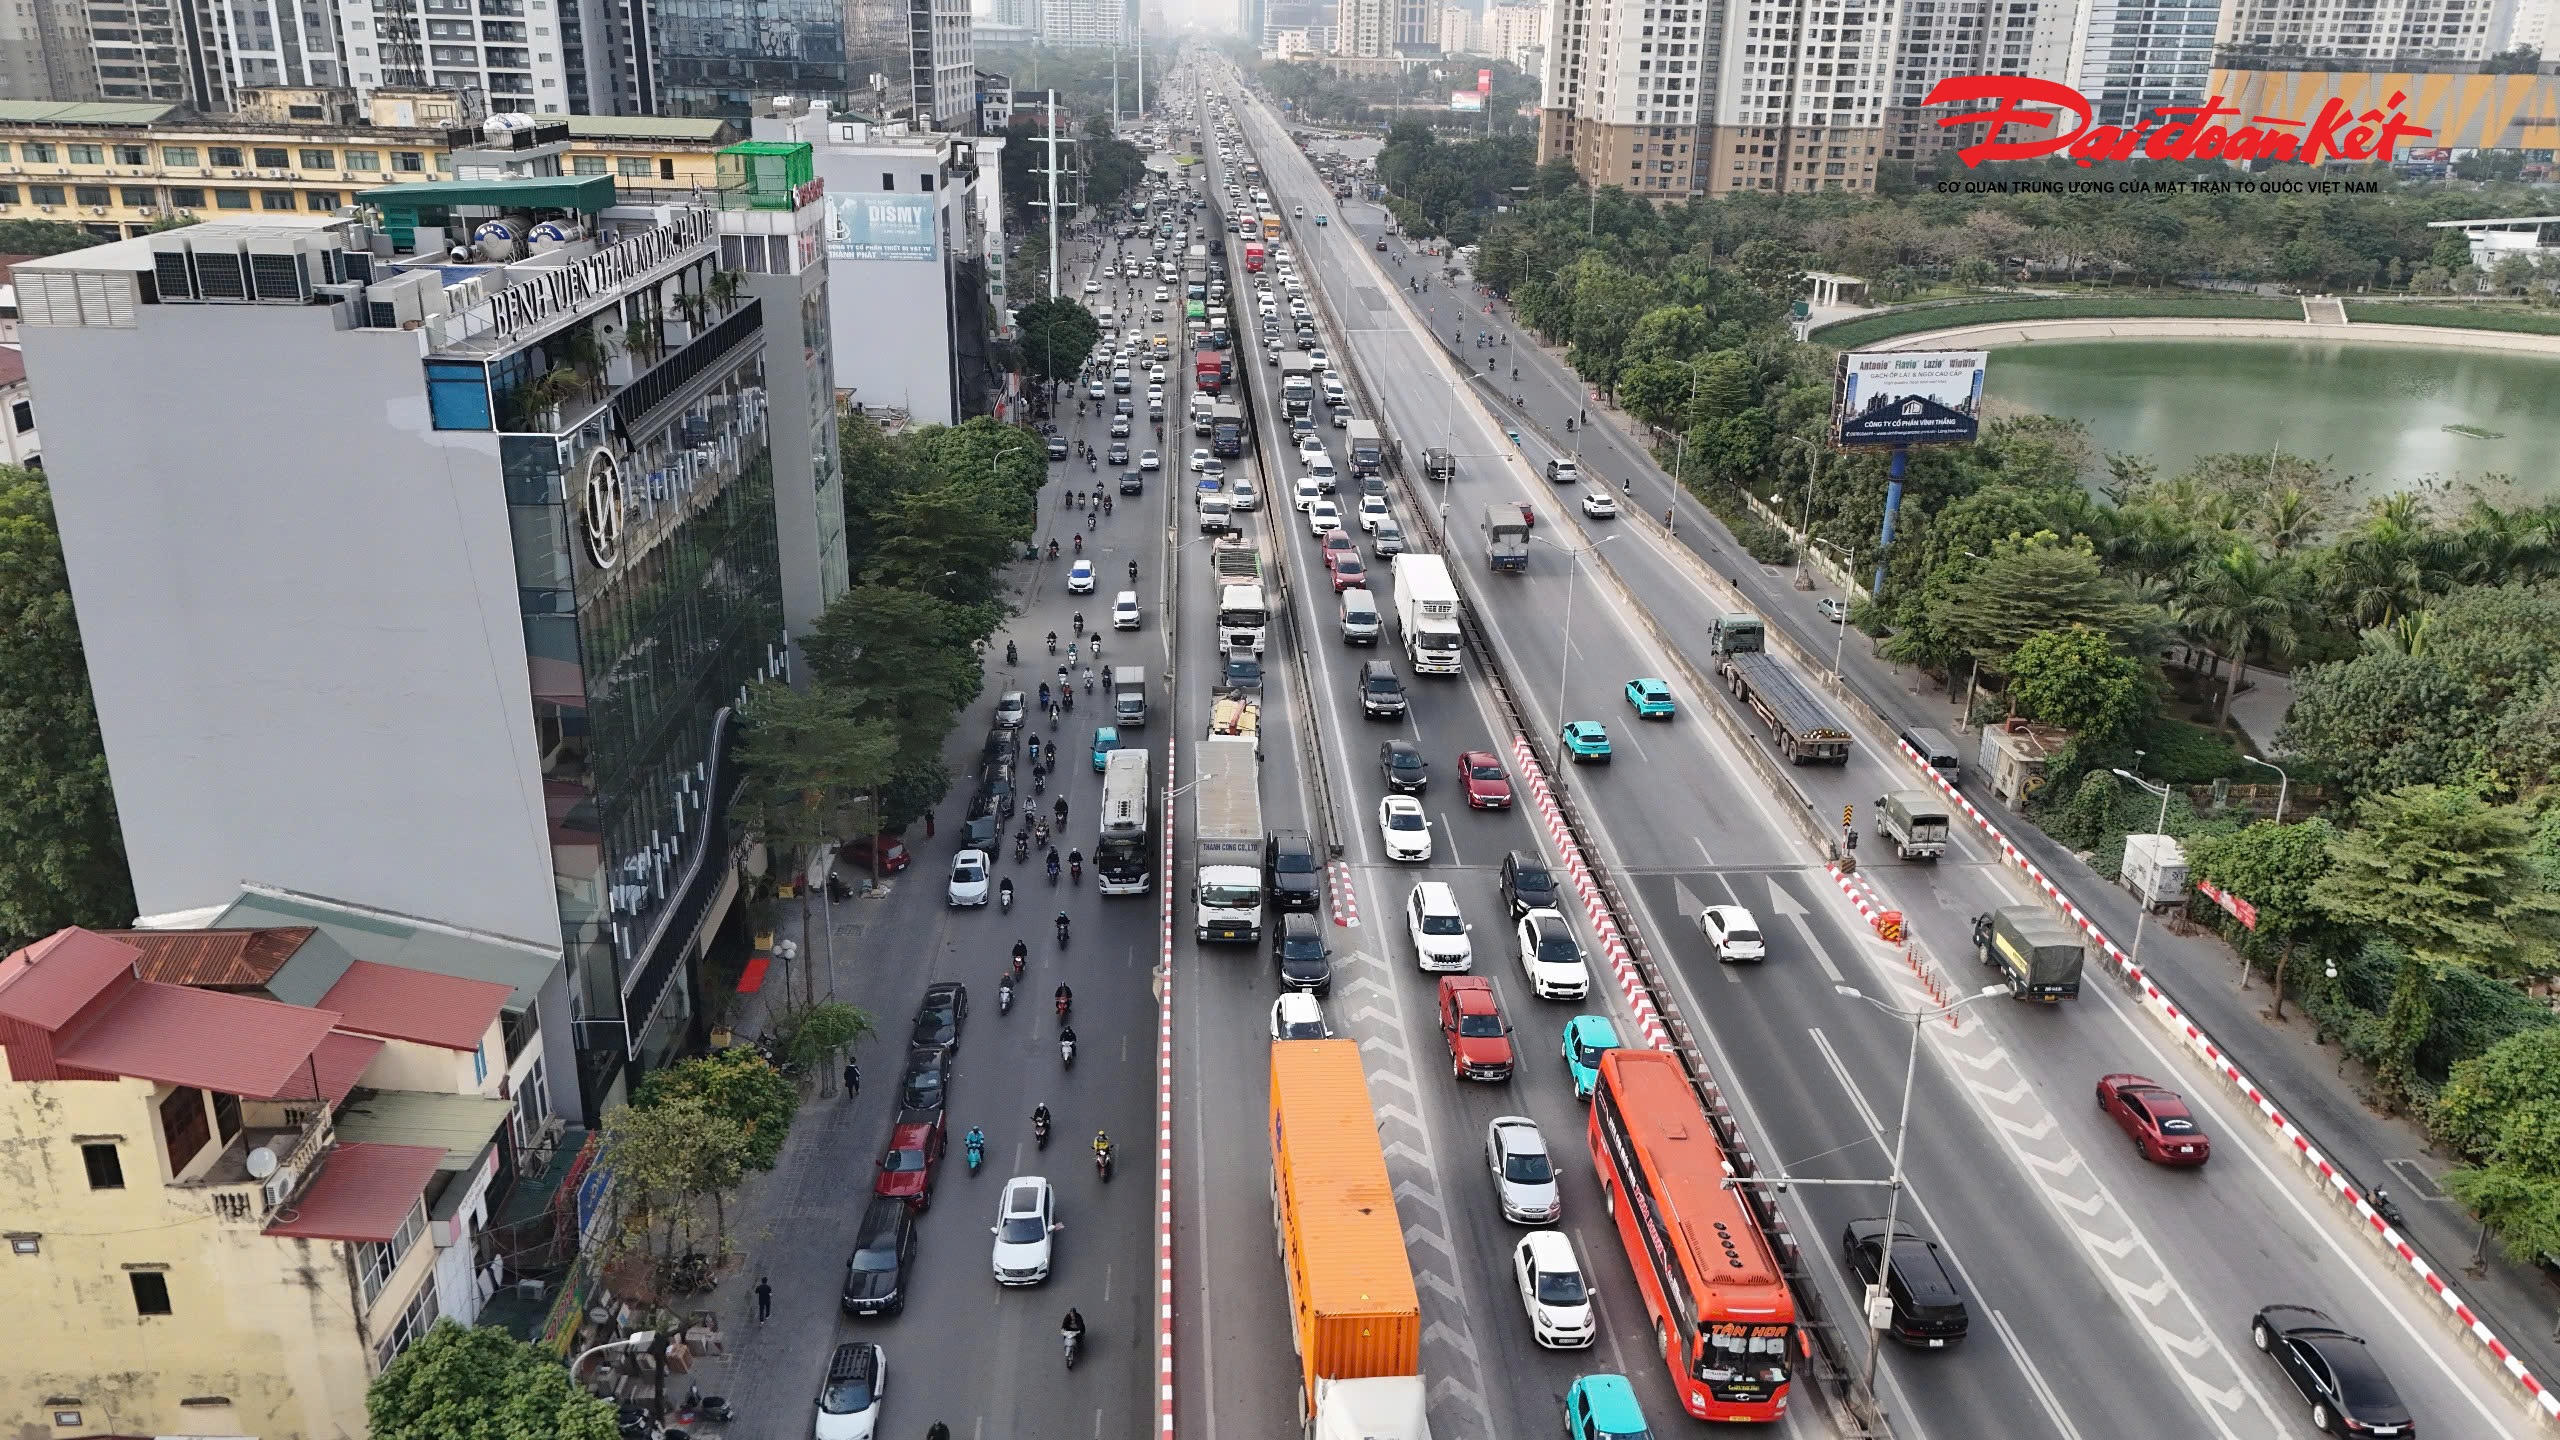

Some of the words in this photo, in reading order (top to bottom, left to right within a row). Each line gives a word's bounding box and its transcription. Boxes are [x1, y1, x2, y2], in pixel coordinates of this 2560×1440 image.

[869, 206, 922, 223] DISMY
[489, 279, 550, 343] BỆNH
[547, 256, 591, 314] VIỆN
[1864, 419, 1882, 428] CÔNG
[1712, 1322, 1747, 1337] TÂN
